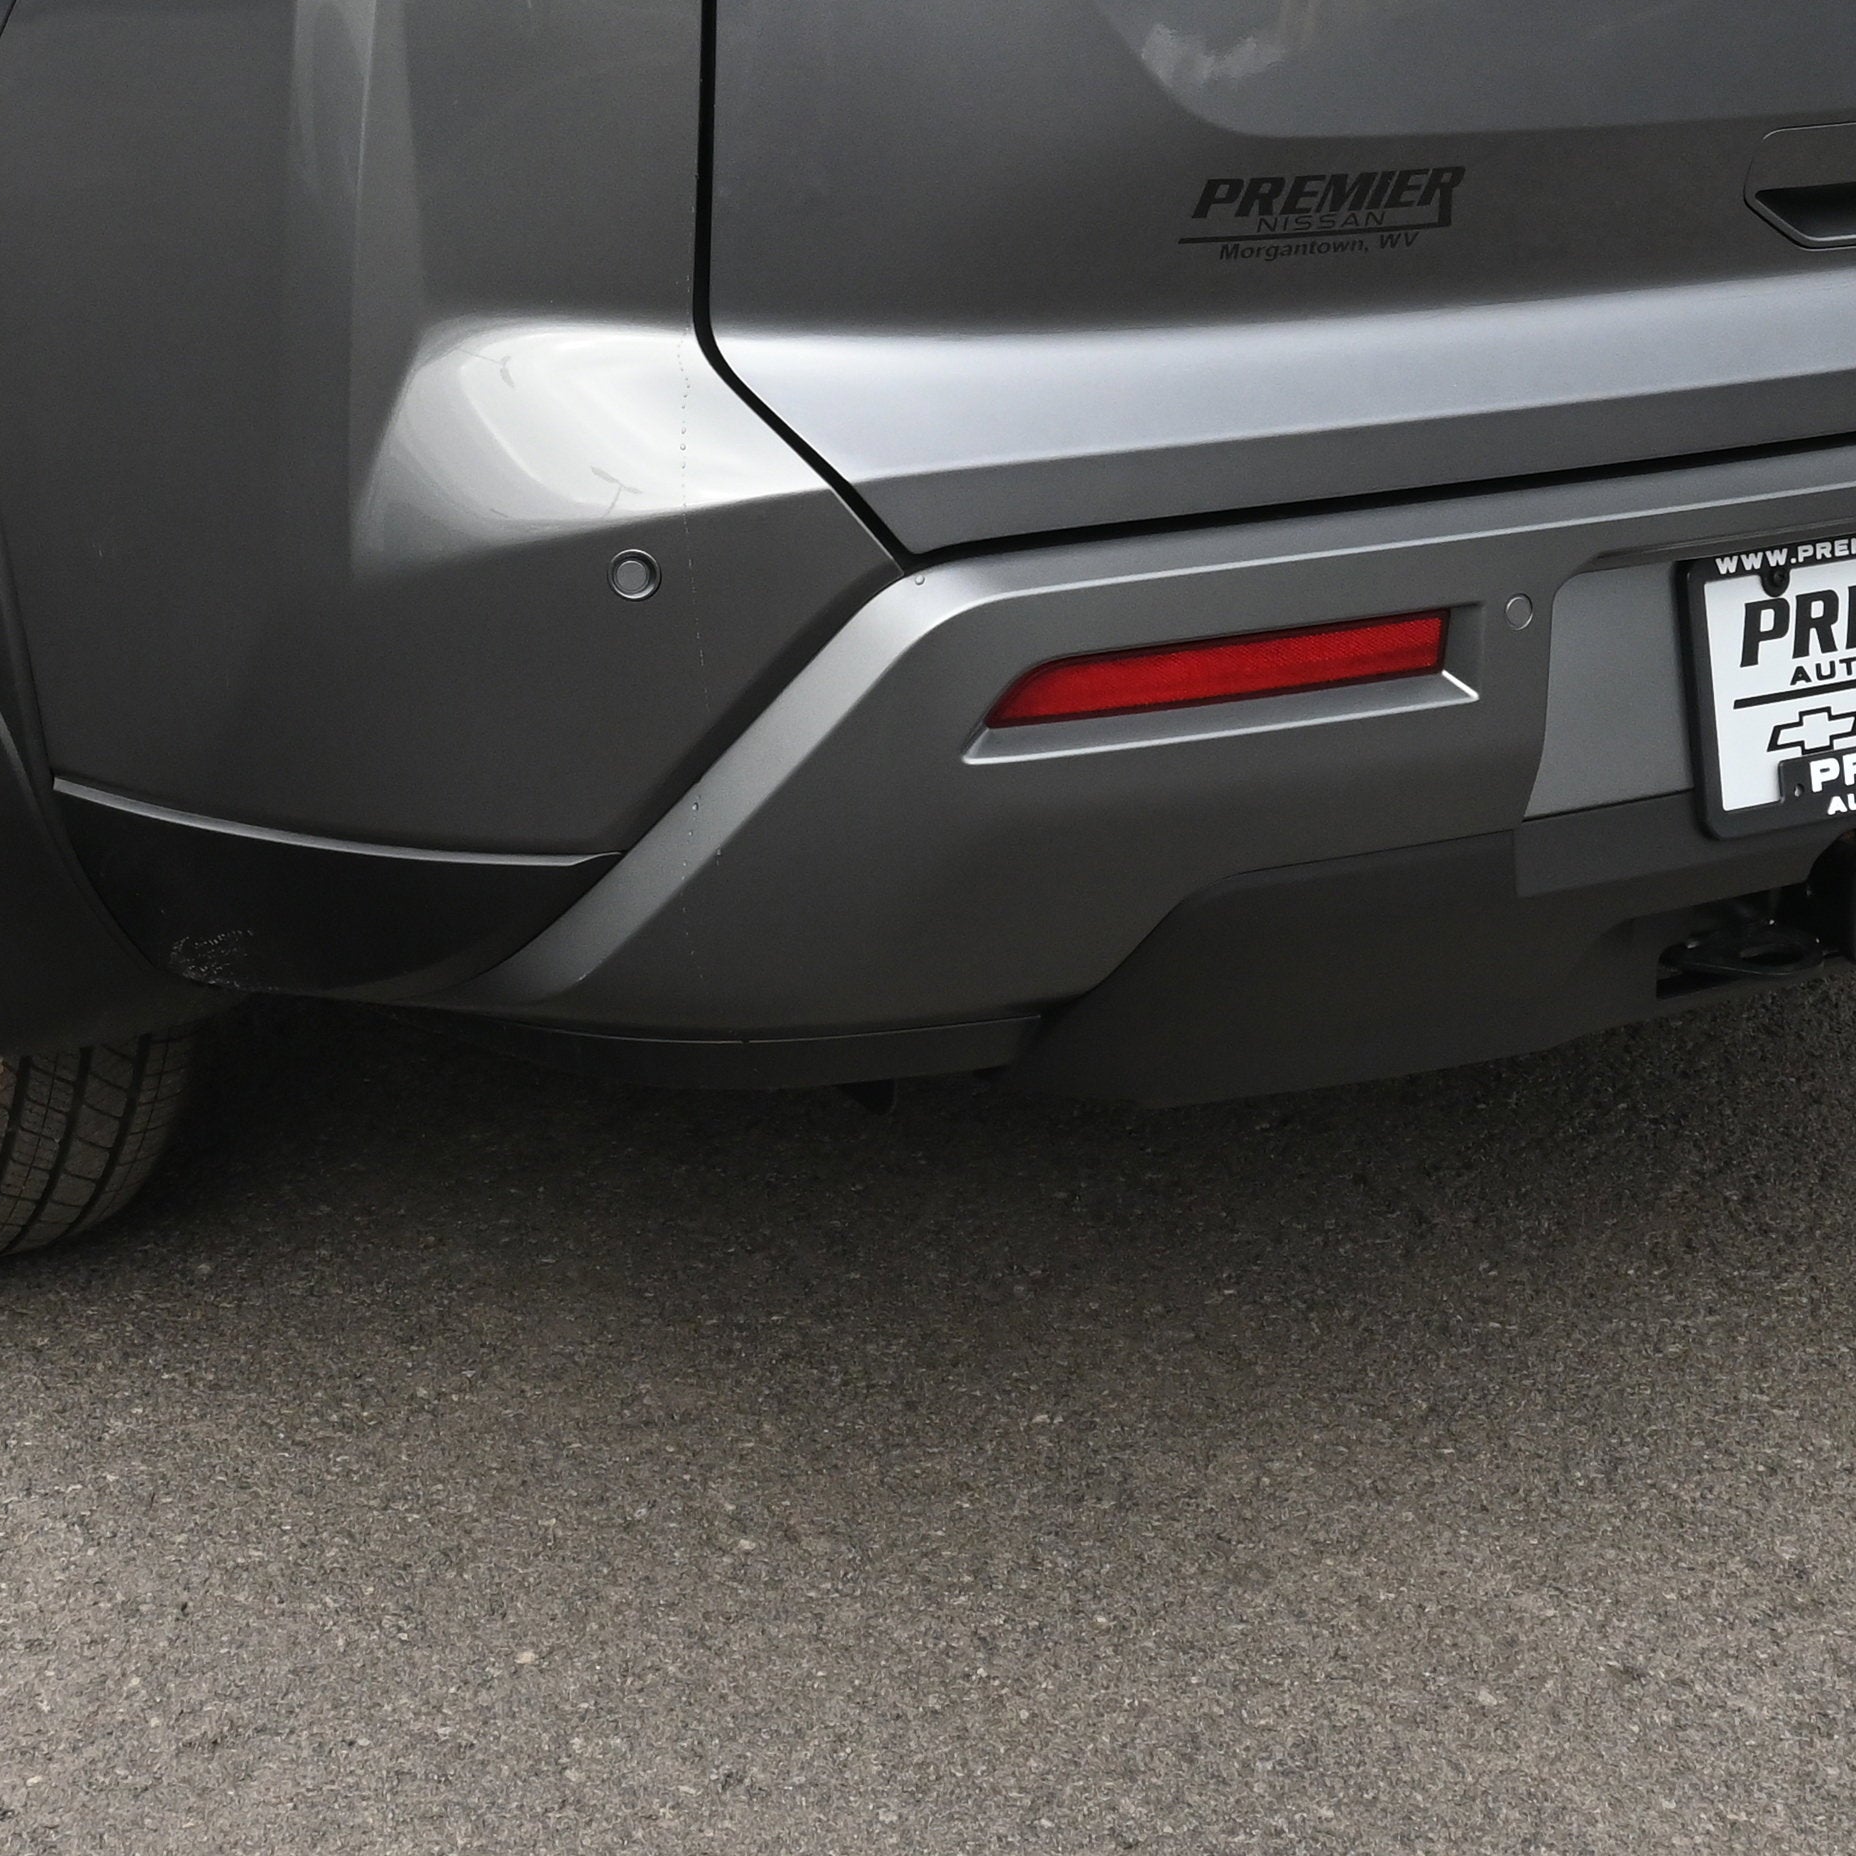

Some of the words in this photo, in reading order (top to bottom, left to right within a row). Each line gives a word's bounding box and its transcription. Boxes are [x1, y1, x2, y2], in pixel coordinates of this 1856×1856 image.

[1191, 166, 1465, 227] PREMIER
[1256, 212, 1386, 233] NISSAN
[1218, 240, 1370, 262] Morgantown,
[1379, 231, 1420, 250] WV
